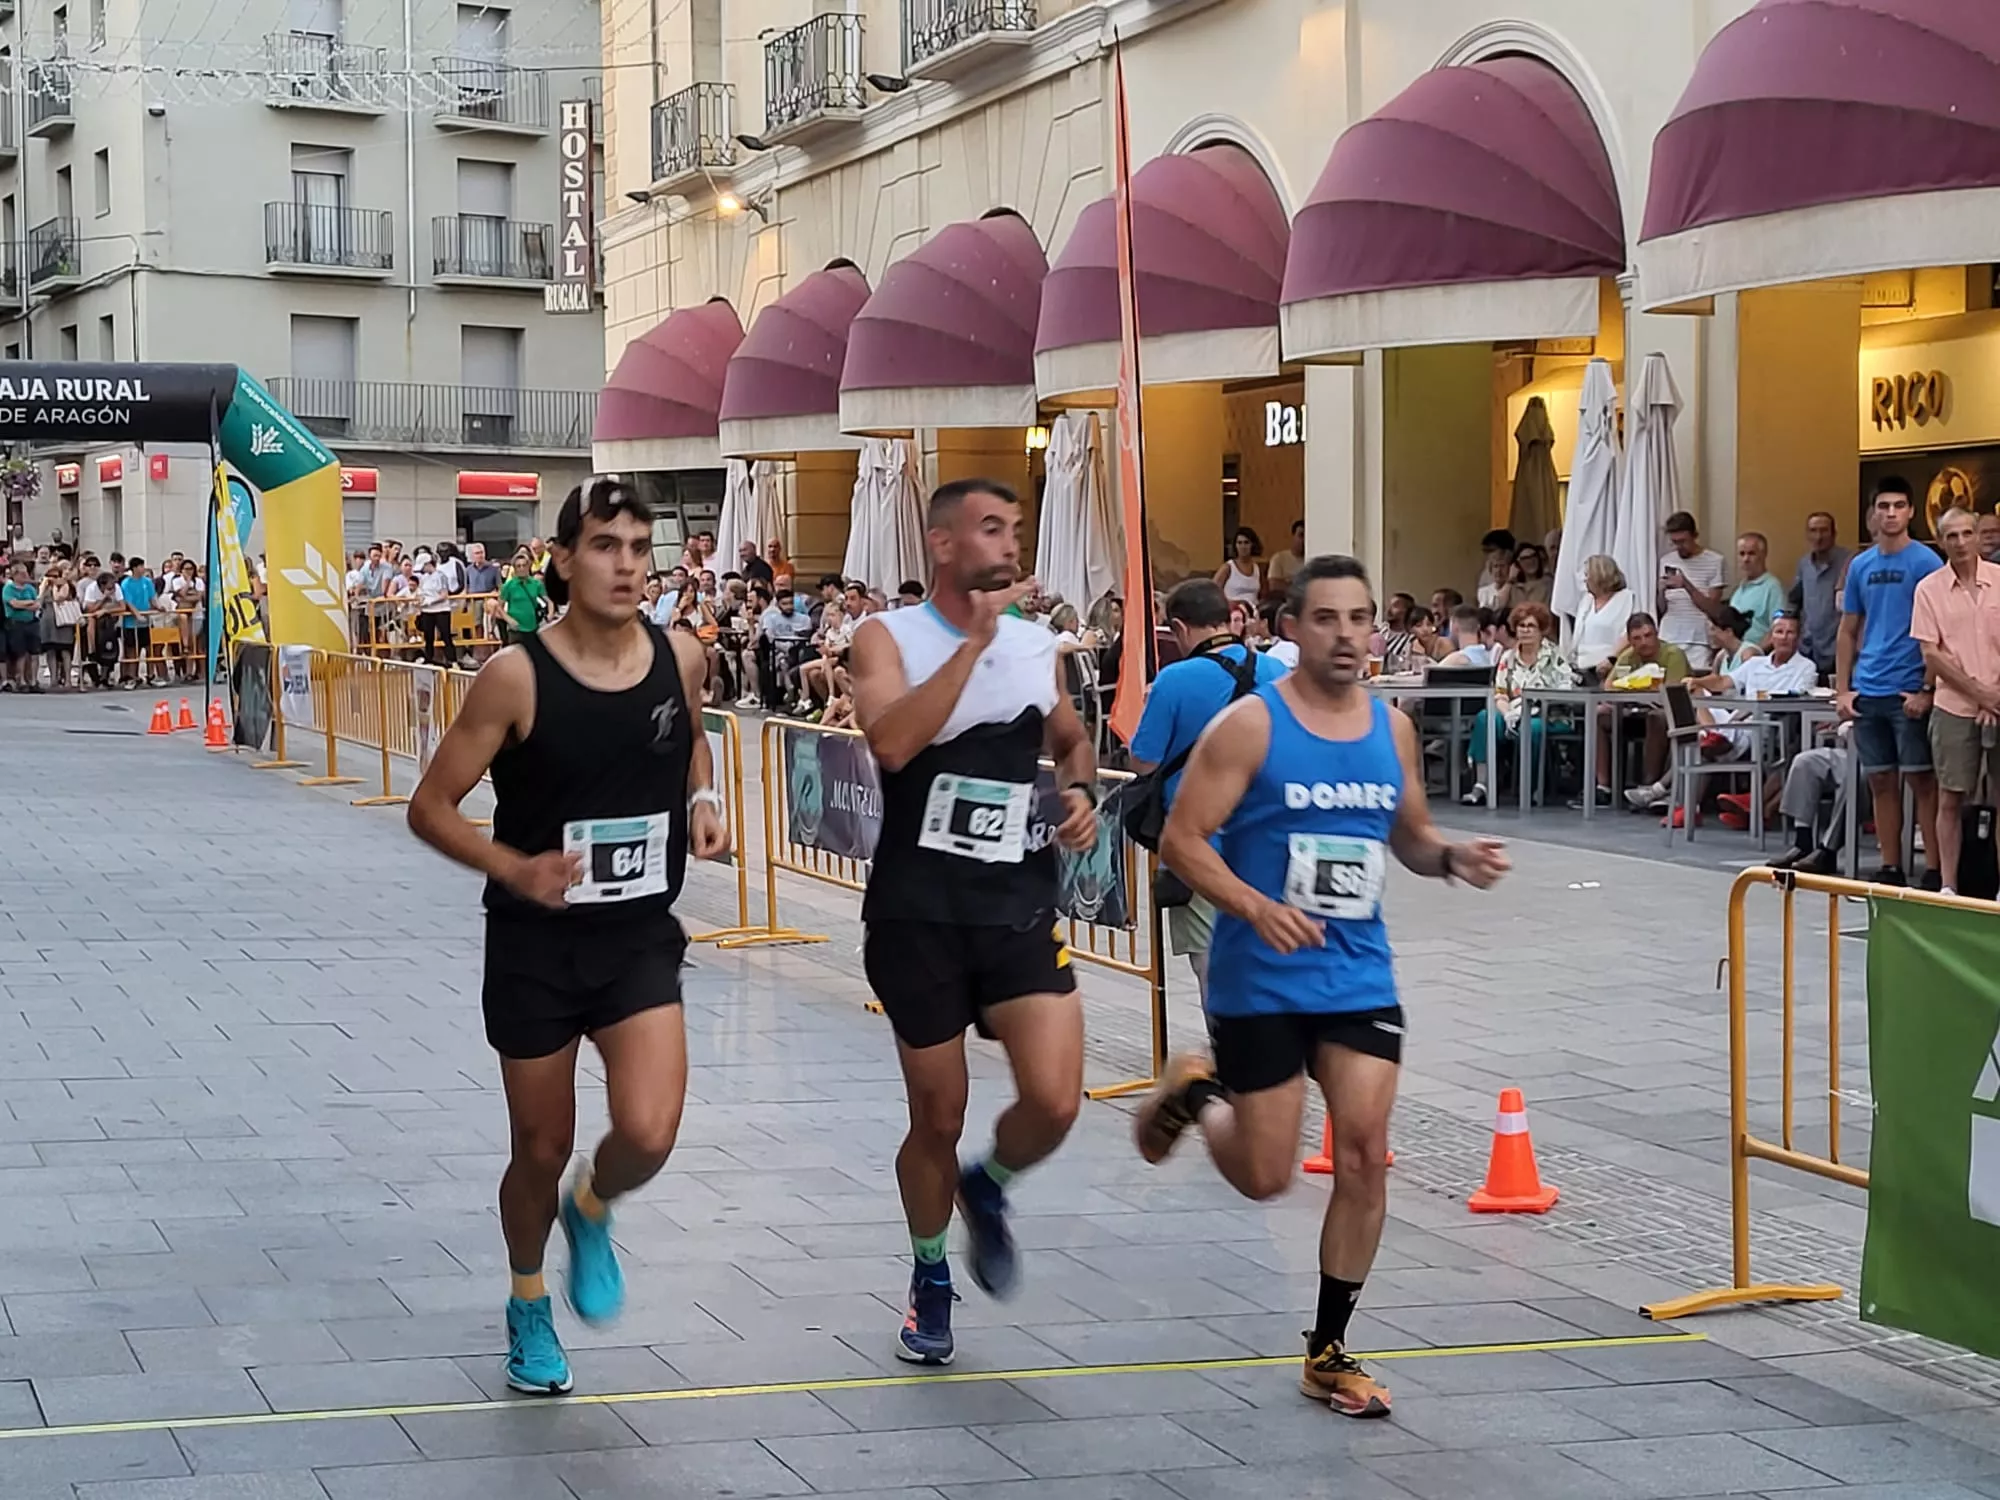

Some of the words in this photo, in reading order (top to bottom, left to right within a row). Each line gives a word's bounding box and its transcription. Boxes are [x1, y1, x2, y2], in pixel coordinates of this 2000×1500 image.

[562, 103, 587, 277] HOSTAL
[55, 379, 151, 402] RURAL
[1871, 370, 1946, 429] RICO
[0, 407, 28, 424] DE
[33, 404, 131, 424] ARAGÓN
[1284, 781, 1397, 811] DOMEC
[968, 806, 1005, 837] 62
[612, 844, 644, 877] 64
